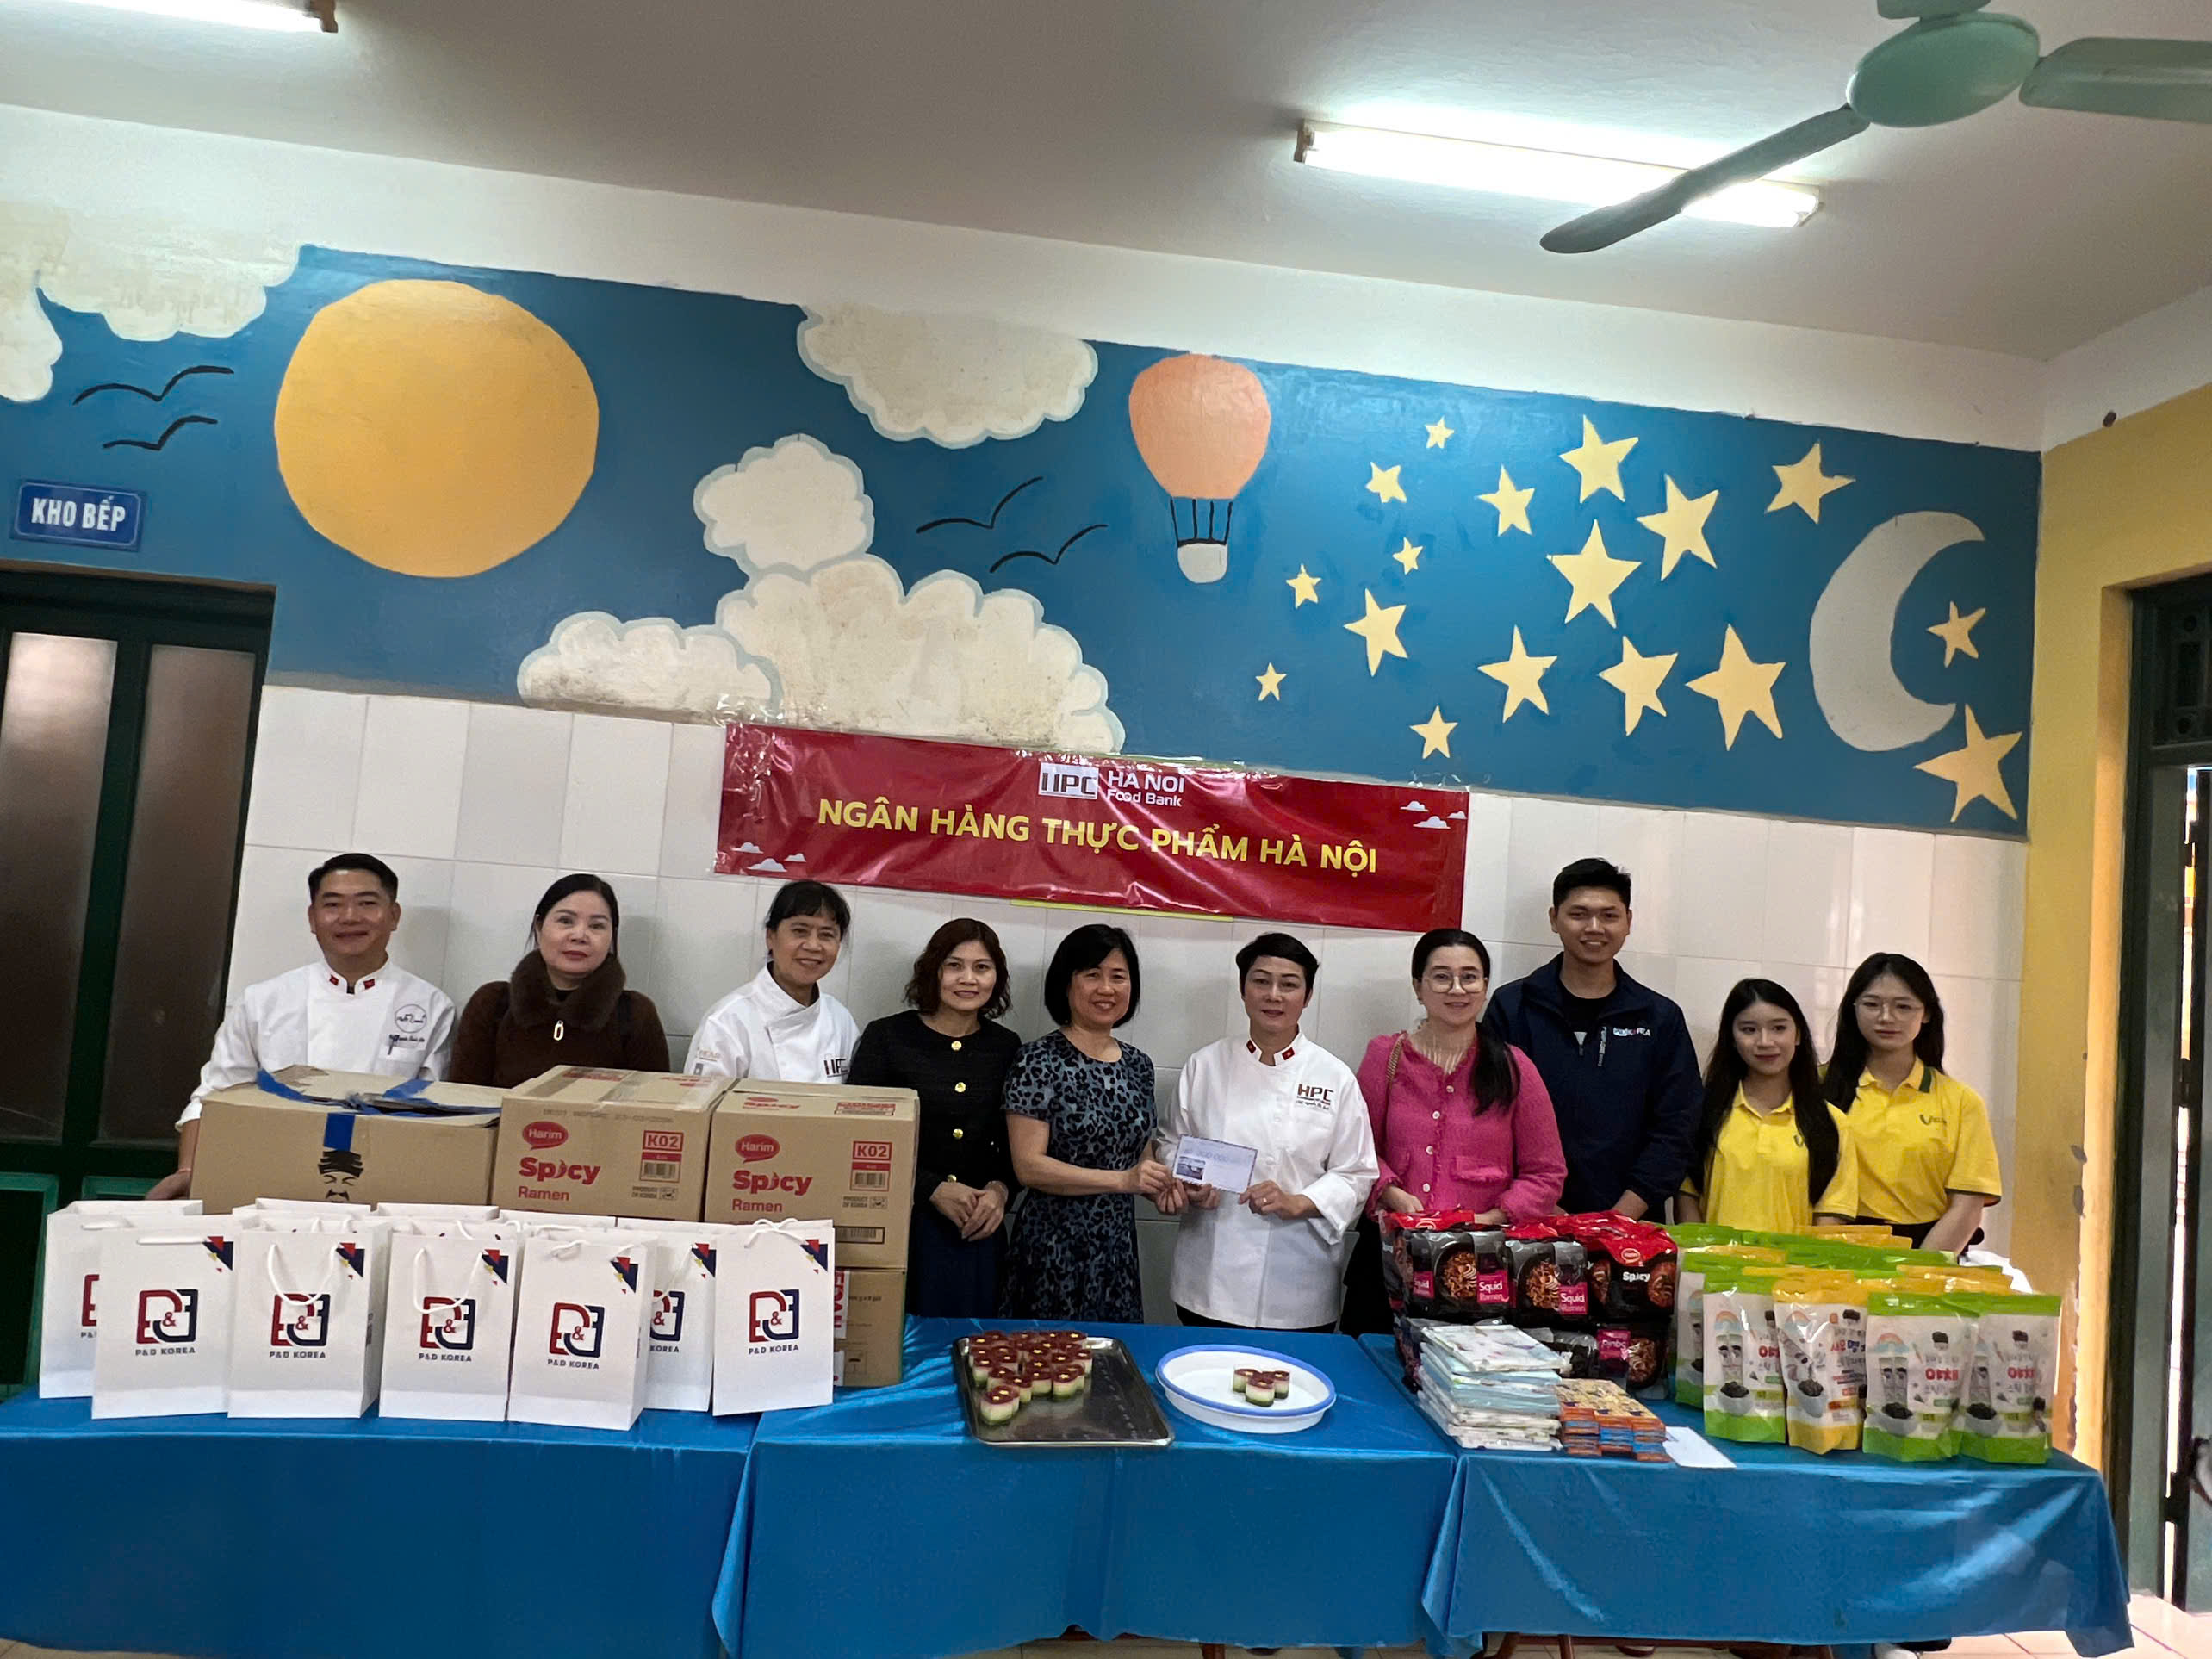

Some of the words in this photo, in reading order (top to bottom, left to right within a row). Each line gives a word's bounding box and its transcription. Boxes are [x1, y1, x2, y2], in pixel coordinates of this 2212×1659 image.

[31, 497, 77, 527] KHO
[82, 495, 126, 531] BẾP
[1108, 770, 1140, 789] HA
[1145, 774, 1185, 793] NOI
[1106, 789, 1141, 804] Food
[1145, 793, 1183, 807] Bank
[818, 796, 919, 832] NGÂN
[930, 804, 1029, 842] HÀNG
[1041, 817, 1140, 854] THỰC
[1150, 823, 1248, 862] PHẨM
[1259, 833, 1308, 867] HÀ
[1320, 839, 1377, 878] NỘI
[1297, 1083, 1334, 1103] HPC
[528, 1128, 562, 1141] Harim
[647, 1134, 679, 1148] K02
[741, 1141, 774, 1153] Harim
[856, 1145, 888, 1158] K02
[519, 1157, 601, 1185] Spicy
[732, 1170, 813, 1196] Spicy
[518, 1185, 569, 1202] Ramen
[731, 1198, 782, 1213] Ramen
[1479, 1280, 1503, 1294] Squid
[1560, 1292, 1586, 1305] Squid
[135, 1348, 157, 1357] P&D
[293, 1351, 326, 1359] KOREA
[649, 1345, 680, 1353] KOREA
[769, 1345, 799, 1353] KOREA
[419, 1352, 438, 1361] P&D
[441, 1353, 472, 1362] KOREA
[547, 1358, 567, 1367] P&D
[569, 1361, 600, 1370] KOREA
